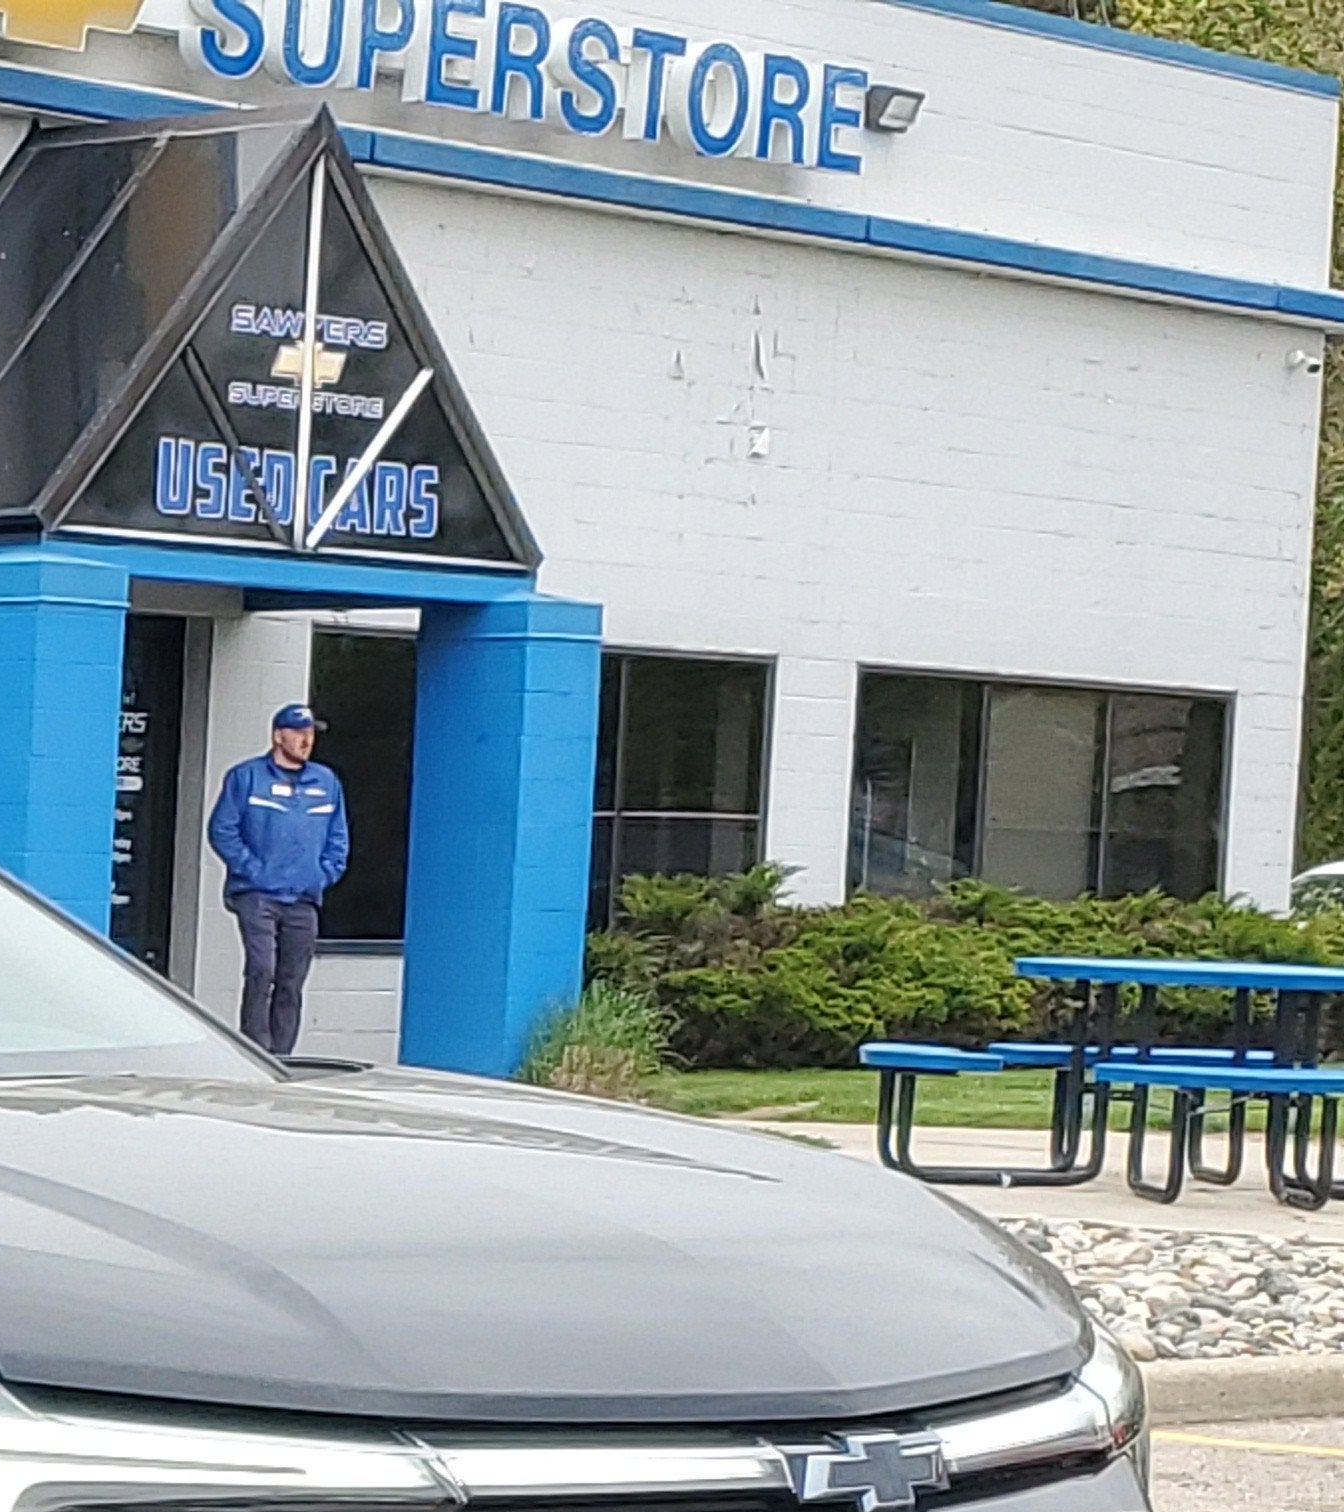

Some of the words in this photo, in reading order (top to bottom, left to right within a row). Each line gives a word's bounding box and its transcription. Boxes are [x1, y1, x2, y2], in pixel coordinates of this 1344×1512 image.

[199, 0, 870, 174] SUPERSTORE
[155, 437, 296, 526] USED
[307, 454, 440, 538] CARS
